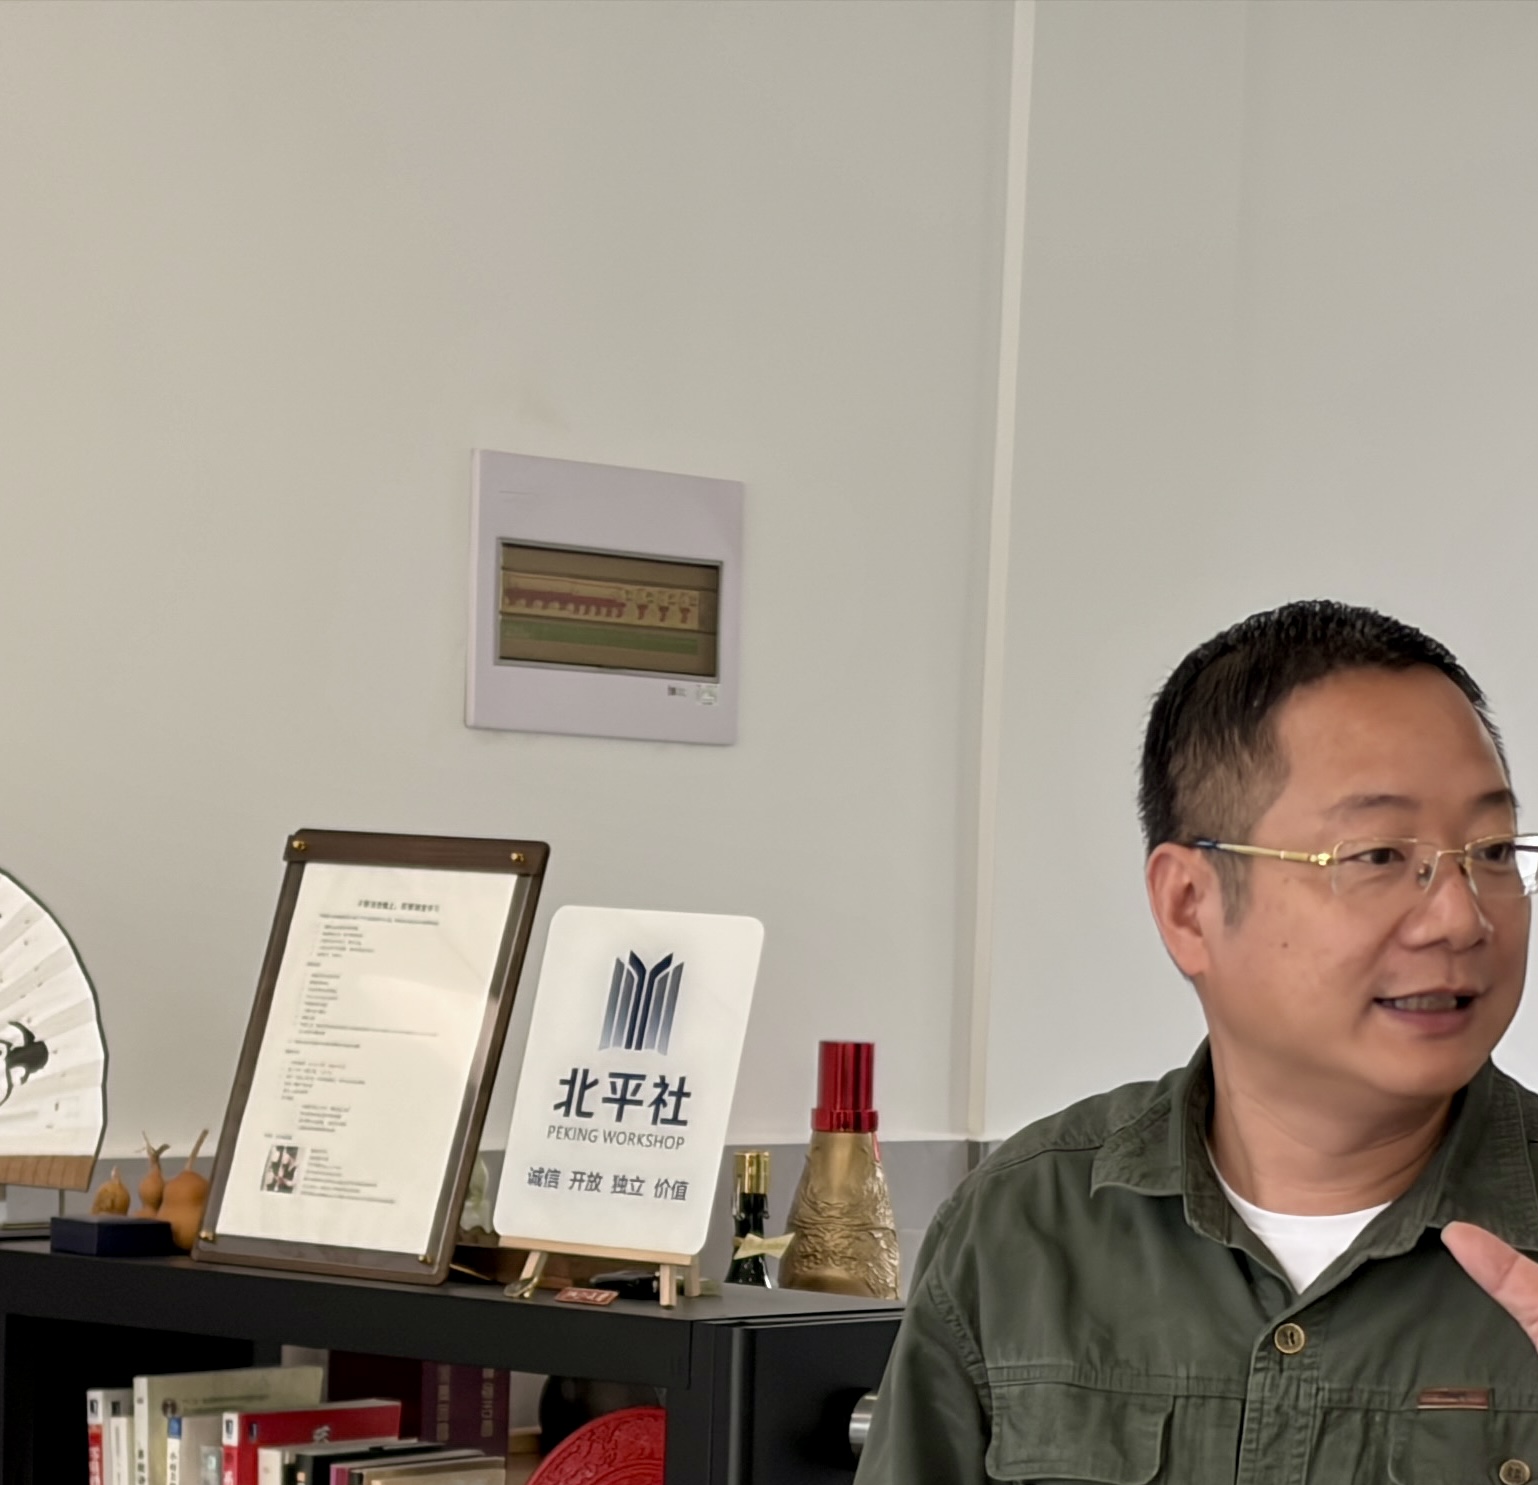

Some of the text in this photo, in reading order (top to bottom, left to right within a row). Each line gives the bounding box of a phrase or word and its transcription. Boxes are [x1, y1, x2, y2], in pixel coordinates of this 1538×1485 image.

[552, 1067, 692, 1127] 北平社
[547, 1125, 685, 1150] PEKING WORKSHOP
[527, 1166, 690, 1201] 诚信 开放 独立 价值
